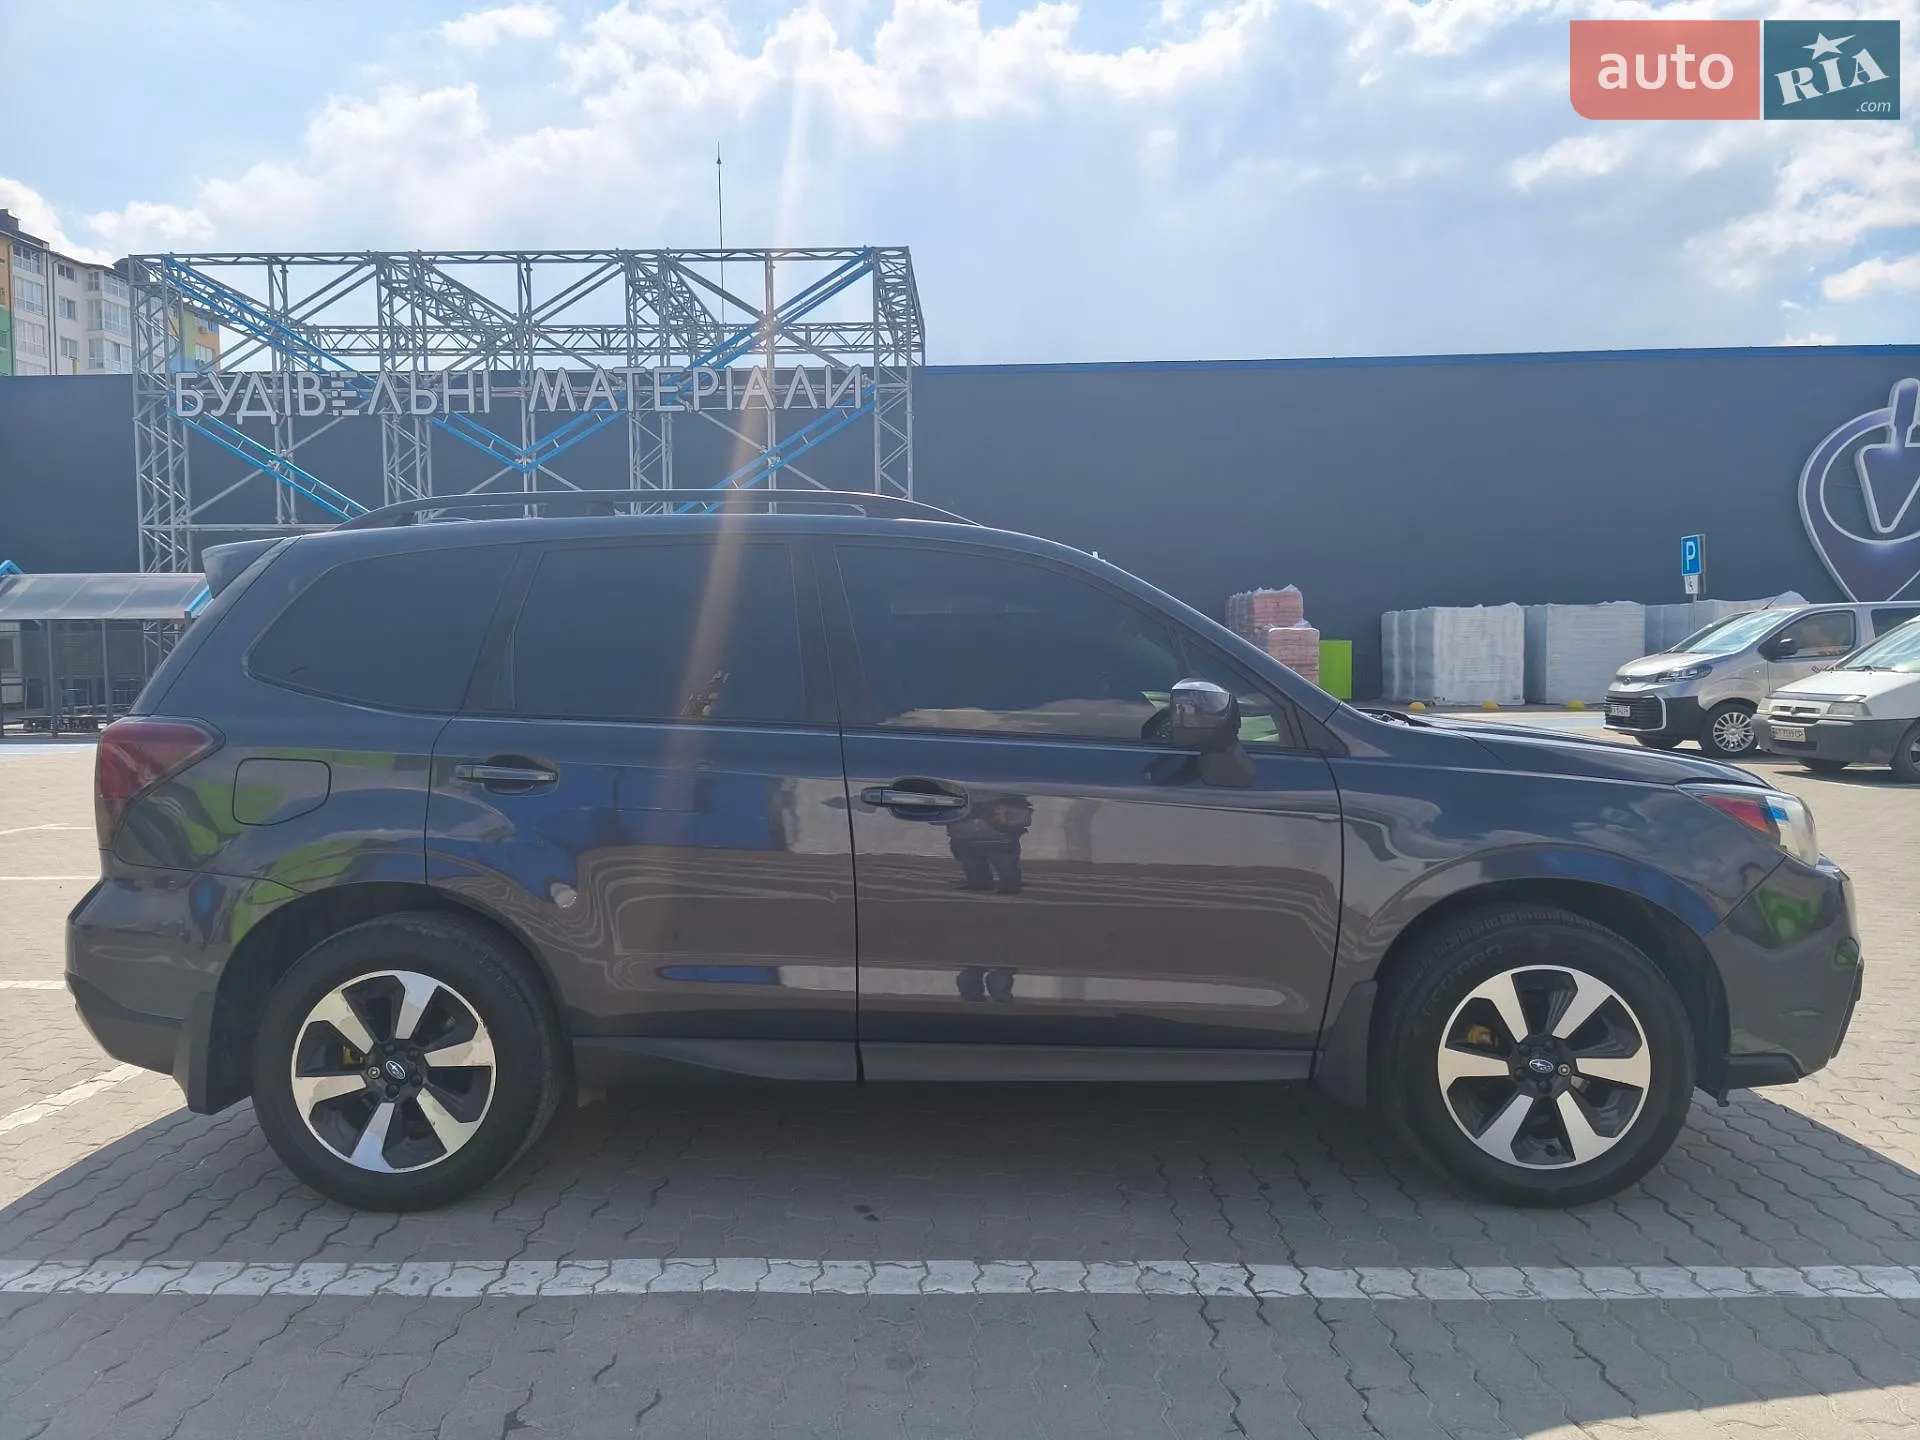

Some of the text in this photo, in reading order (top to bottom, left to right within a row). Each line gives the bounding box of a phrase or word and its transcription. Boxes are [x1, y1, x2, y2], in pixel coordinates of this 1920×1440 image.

[175, 364, 862, 425] БУДІВЕЛЬНІ МАТЕРІАЛИ
[1686, 541, 1696, 571] P
